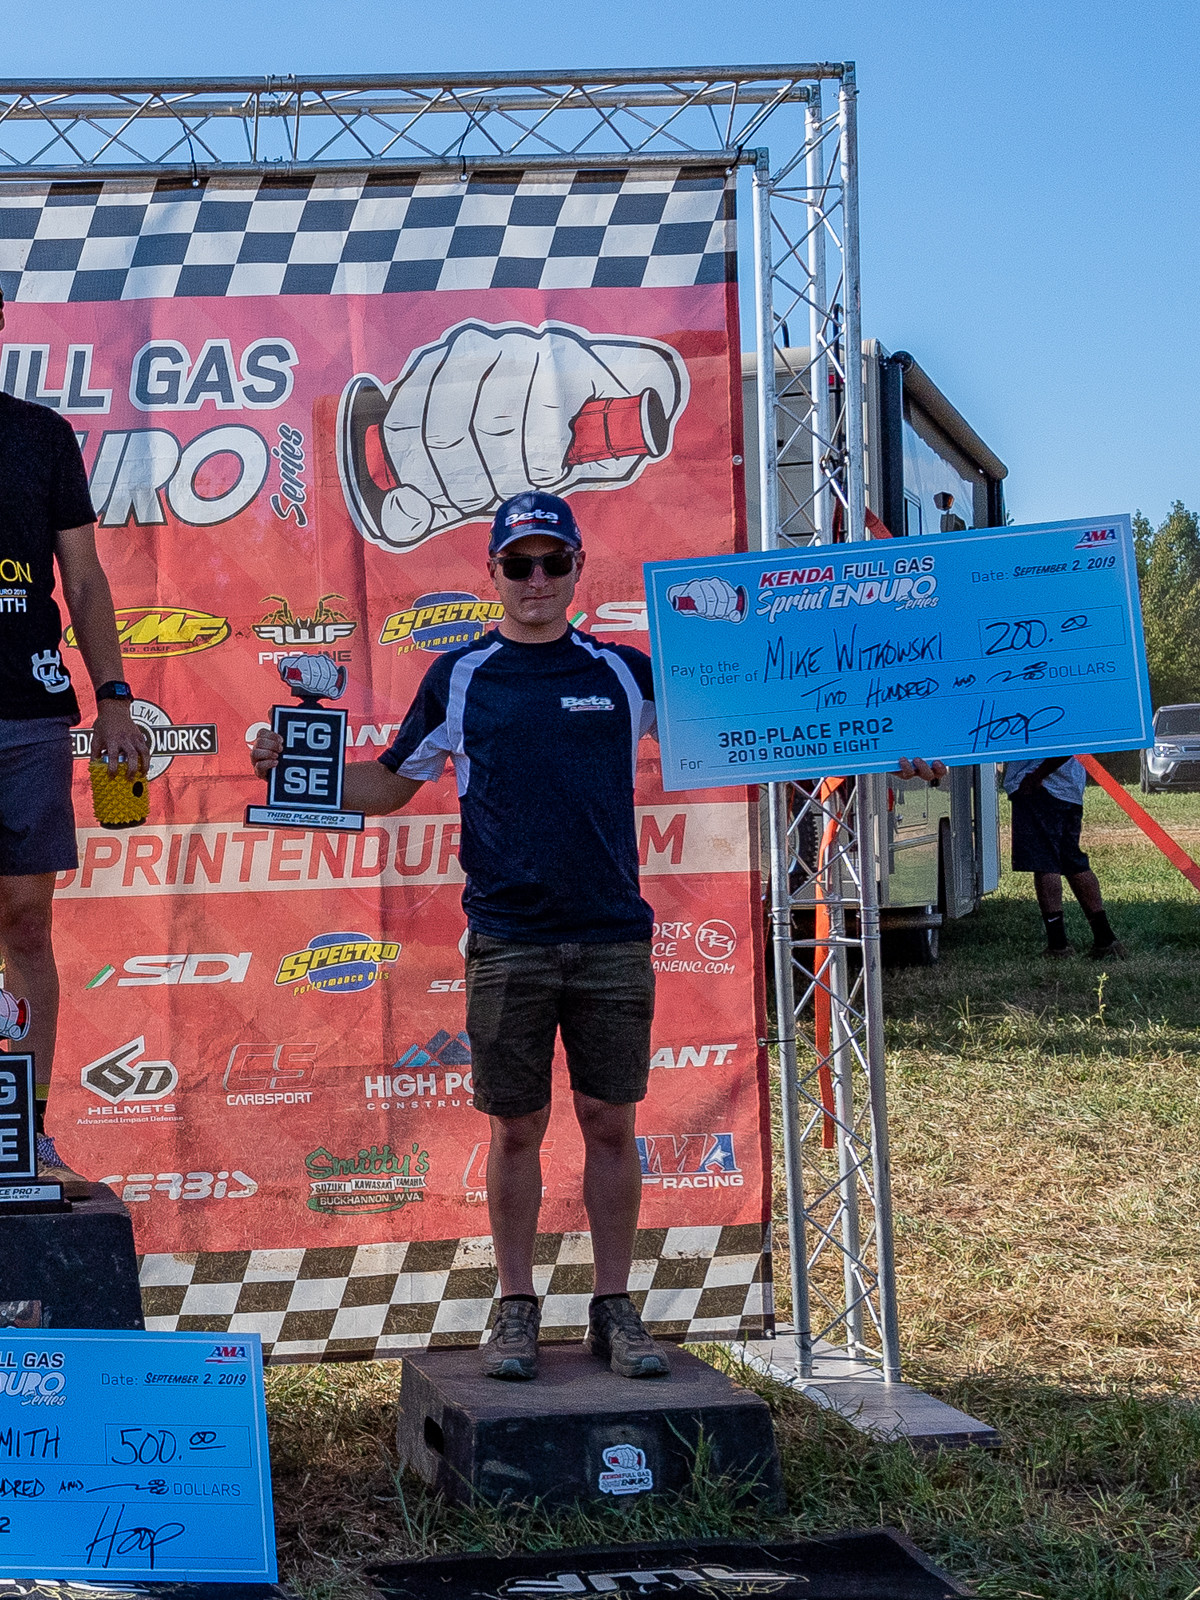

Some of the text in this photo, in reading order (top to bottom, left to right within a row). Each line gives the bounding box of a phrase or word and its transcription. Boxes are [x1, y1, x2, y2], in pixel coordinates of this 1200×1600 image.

[130, 337, 299, 412] GAS
[270, 422, 308, 528] Series
[1077, 528, 1117, 544] AMA
[759, 556, 935, 590] KENDA FULL GAS
[971, 570, 1009, 583] Date:
[1087, 556, 1116, 570] 2019
[755, 576, 938, 624] Sprint ENDURO
[671, 661, 740, 678] Pay to the
[764, 636, 824, 683] MIKE
[1049, 661, 1116, 679] DOLLARS
[700, 670, 759, 686] Order of
[865, 677, 939, 708] HUNDRED
[157, 729, 211, 751] WORKS
[286, 720, 331, 750] FG
[718, 718, 894, 748] 3RD-PLACE PRO2
[728, 738, 880, 763] 2019 ROUND EIGHT
[680, 758, 703, 770] For
[284, 766, 329, 796] SE
[294, 813, 319, 821] PLACE
[274, 940, 402, 986] SPECTRO
[293, 972, 364, 996] Performance
[364, 1072, 437, 1098] HIGH
[88, 1104, 176, 1115] HELMETS
[226, 1091, 313, 1106] CARBSPORT
[77, 1117, 119, 1125] Advanced
[120, 1116, 149, 1124] Impact
[305, 1142, 430, 1180] Smitty's
[315, 1177, 424, 1193] SUZUKI KAWASAKI YAMAHA
[662, 1174, 744, 1188] RACING
[23, 1352, 65, 1369] GAS
[209, 1345, 246, 1358] AMA
[101, 1373, 138, 1386] Date:
[218, 1373, 247, 1385] 2019
[174, 1483, 241, 1496] DOLLARS
